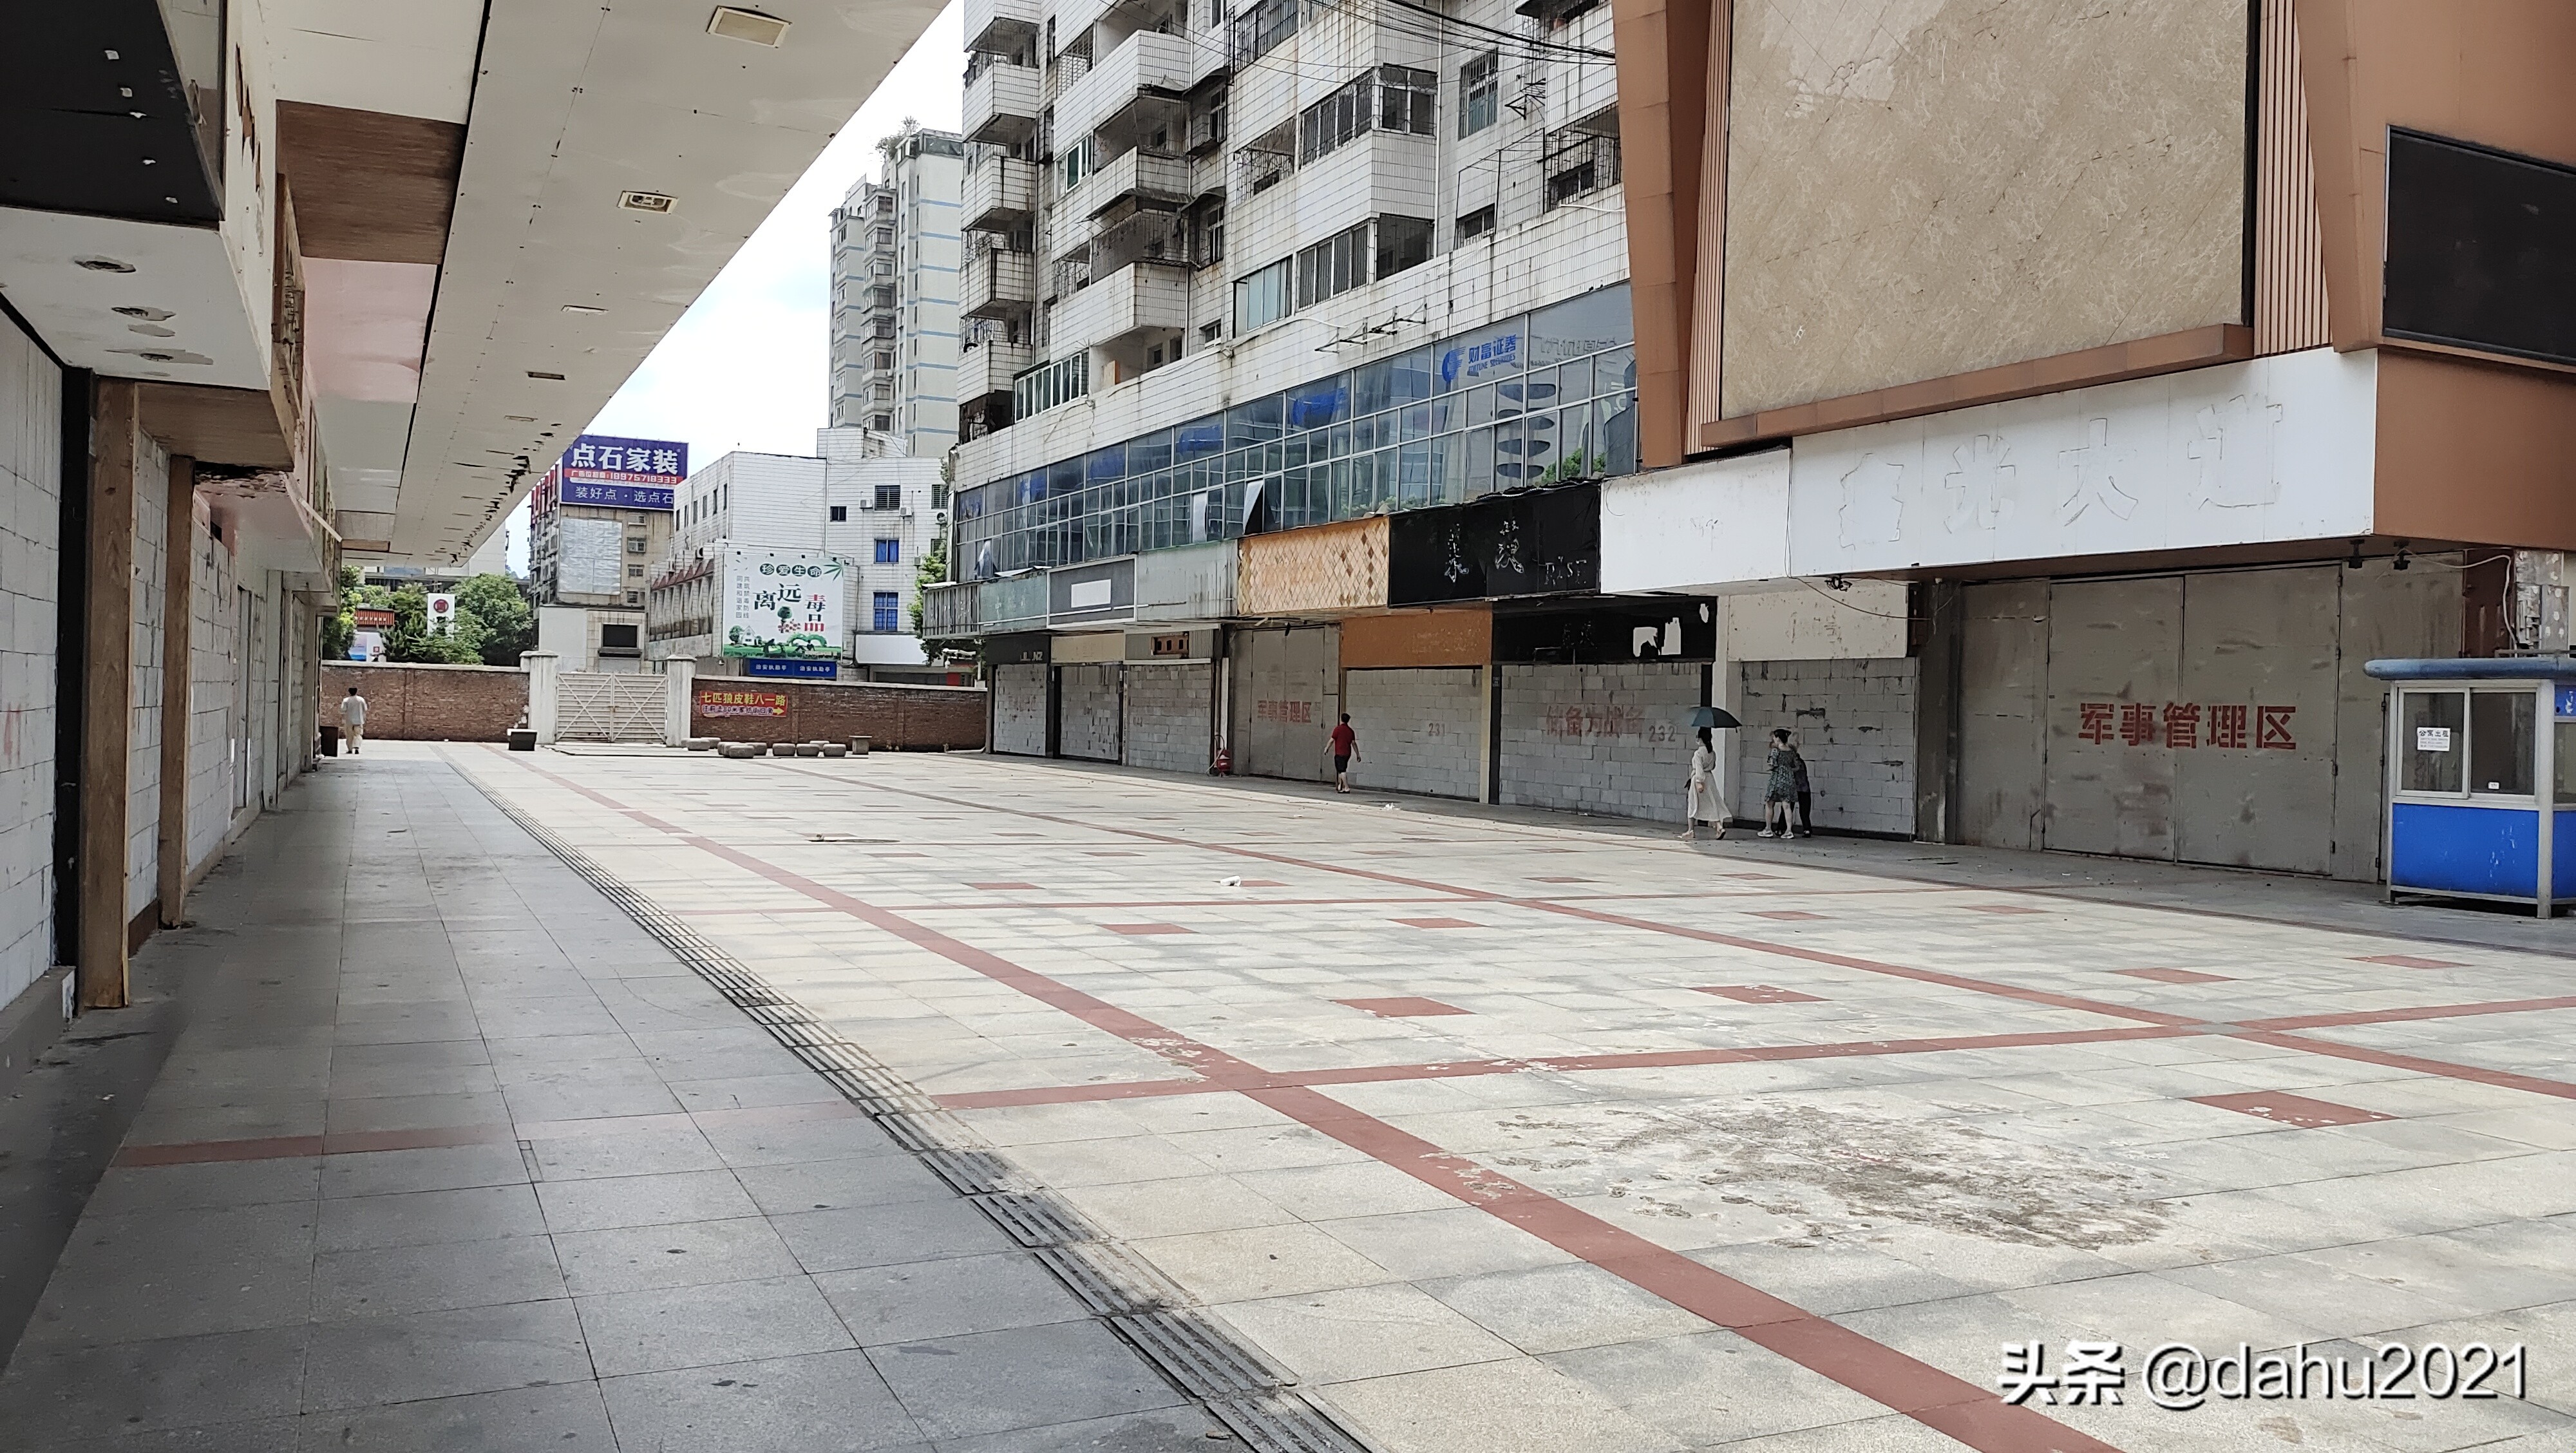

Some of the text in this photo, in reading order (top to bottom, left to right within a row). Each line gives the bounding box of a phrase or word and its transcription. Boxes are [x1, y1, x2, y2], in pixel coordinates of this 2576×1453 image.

[1468, 334, 1517, 364] 财富证券
[571, 442, 678, 475] 点石家装
[761, 564, 822, 577] 珍爱生命
[701, 692, 786, 707] 七匹狼皮鞋八一路
[1257, 699, 1312, 723] 军事管理区
[1428, 723, 1445, 737] 231
[1648, 724, 1676, 742] 232
[2078, 702, 2297, 750] 军事管理区
